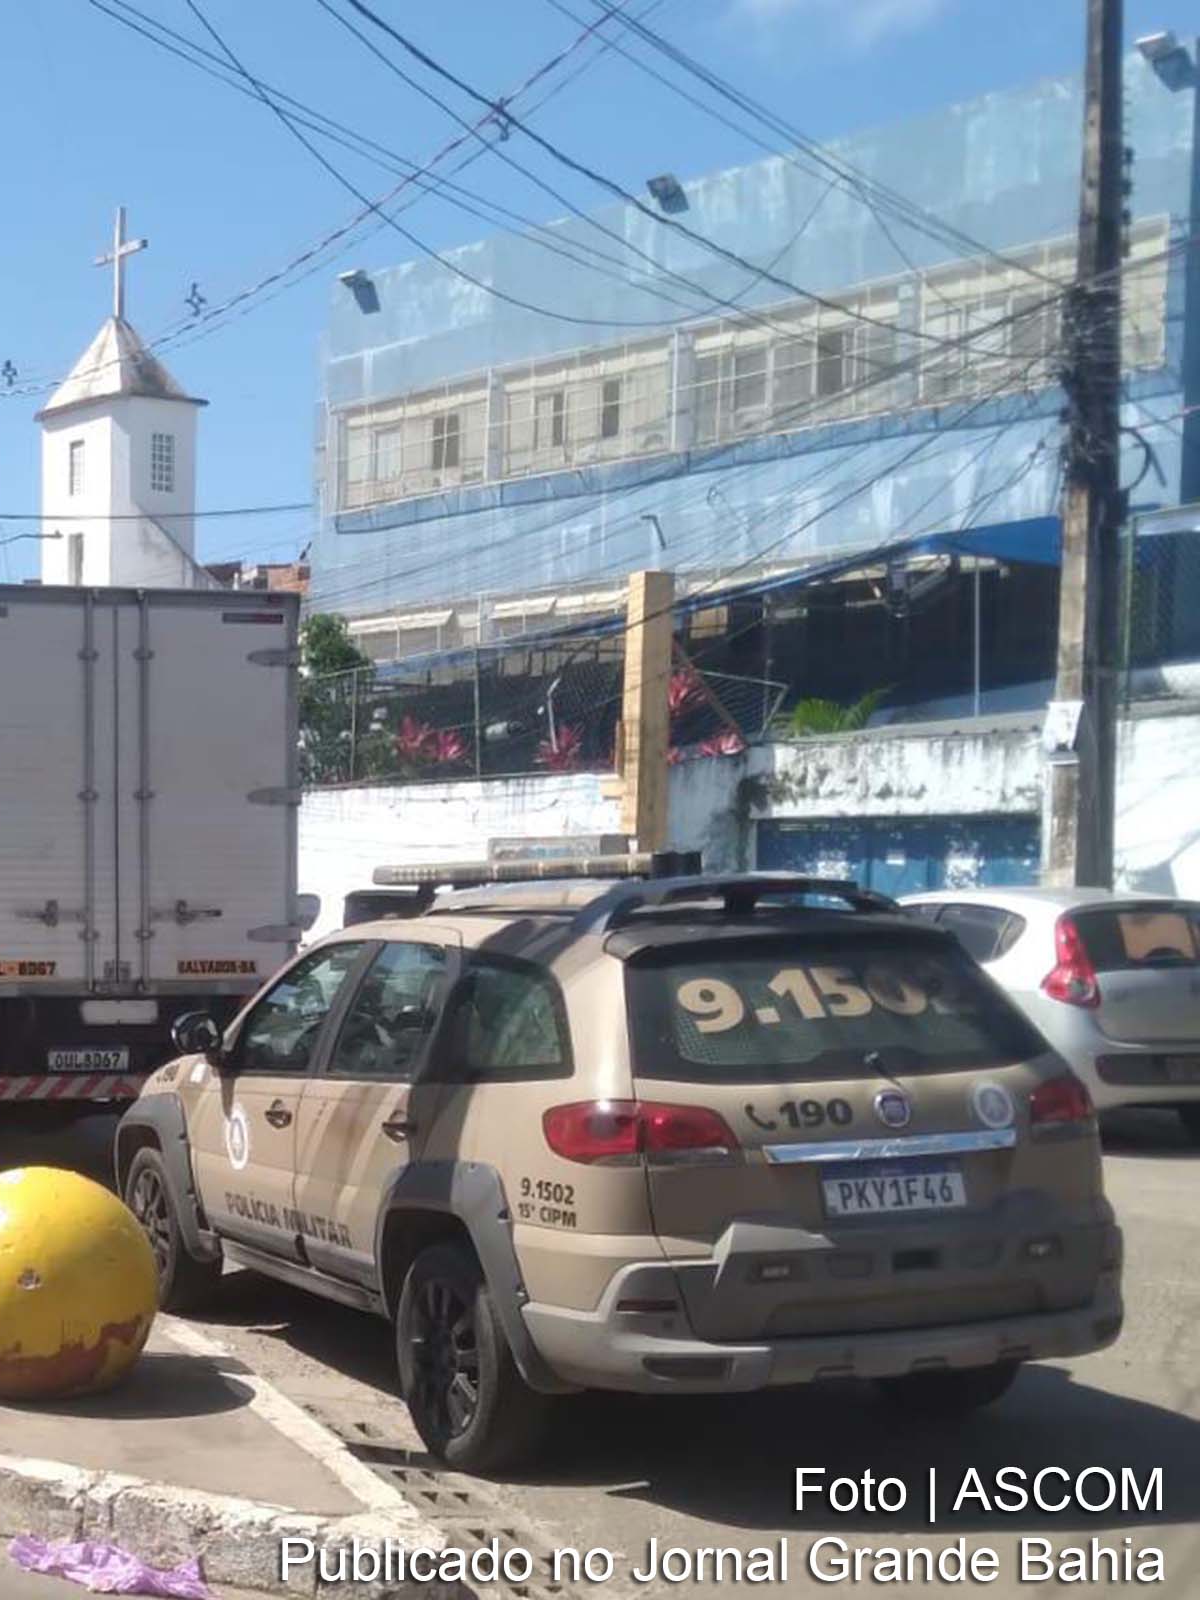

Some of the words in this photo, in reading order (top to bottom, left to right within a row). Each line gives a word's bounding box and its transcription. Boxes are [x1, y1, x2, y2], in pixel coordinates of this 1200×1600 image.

[677, 967, 953, 1033] 9.150
[779, 1098, 853, 1128] 190
[521, 1176, 575, 1206] 9.1502
[837, 1176, 952, 1211] PKY1F46
[282, 1206, 353, 1249] MILITAR
[540, 1206, 577, 1228] CIPM
